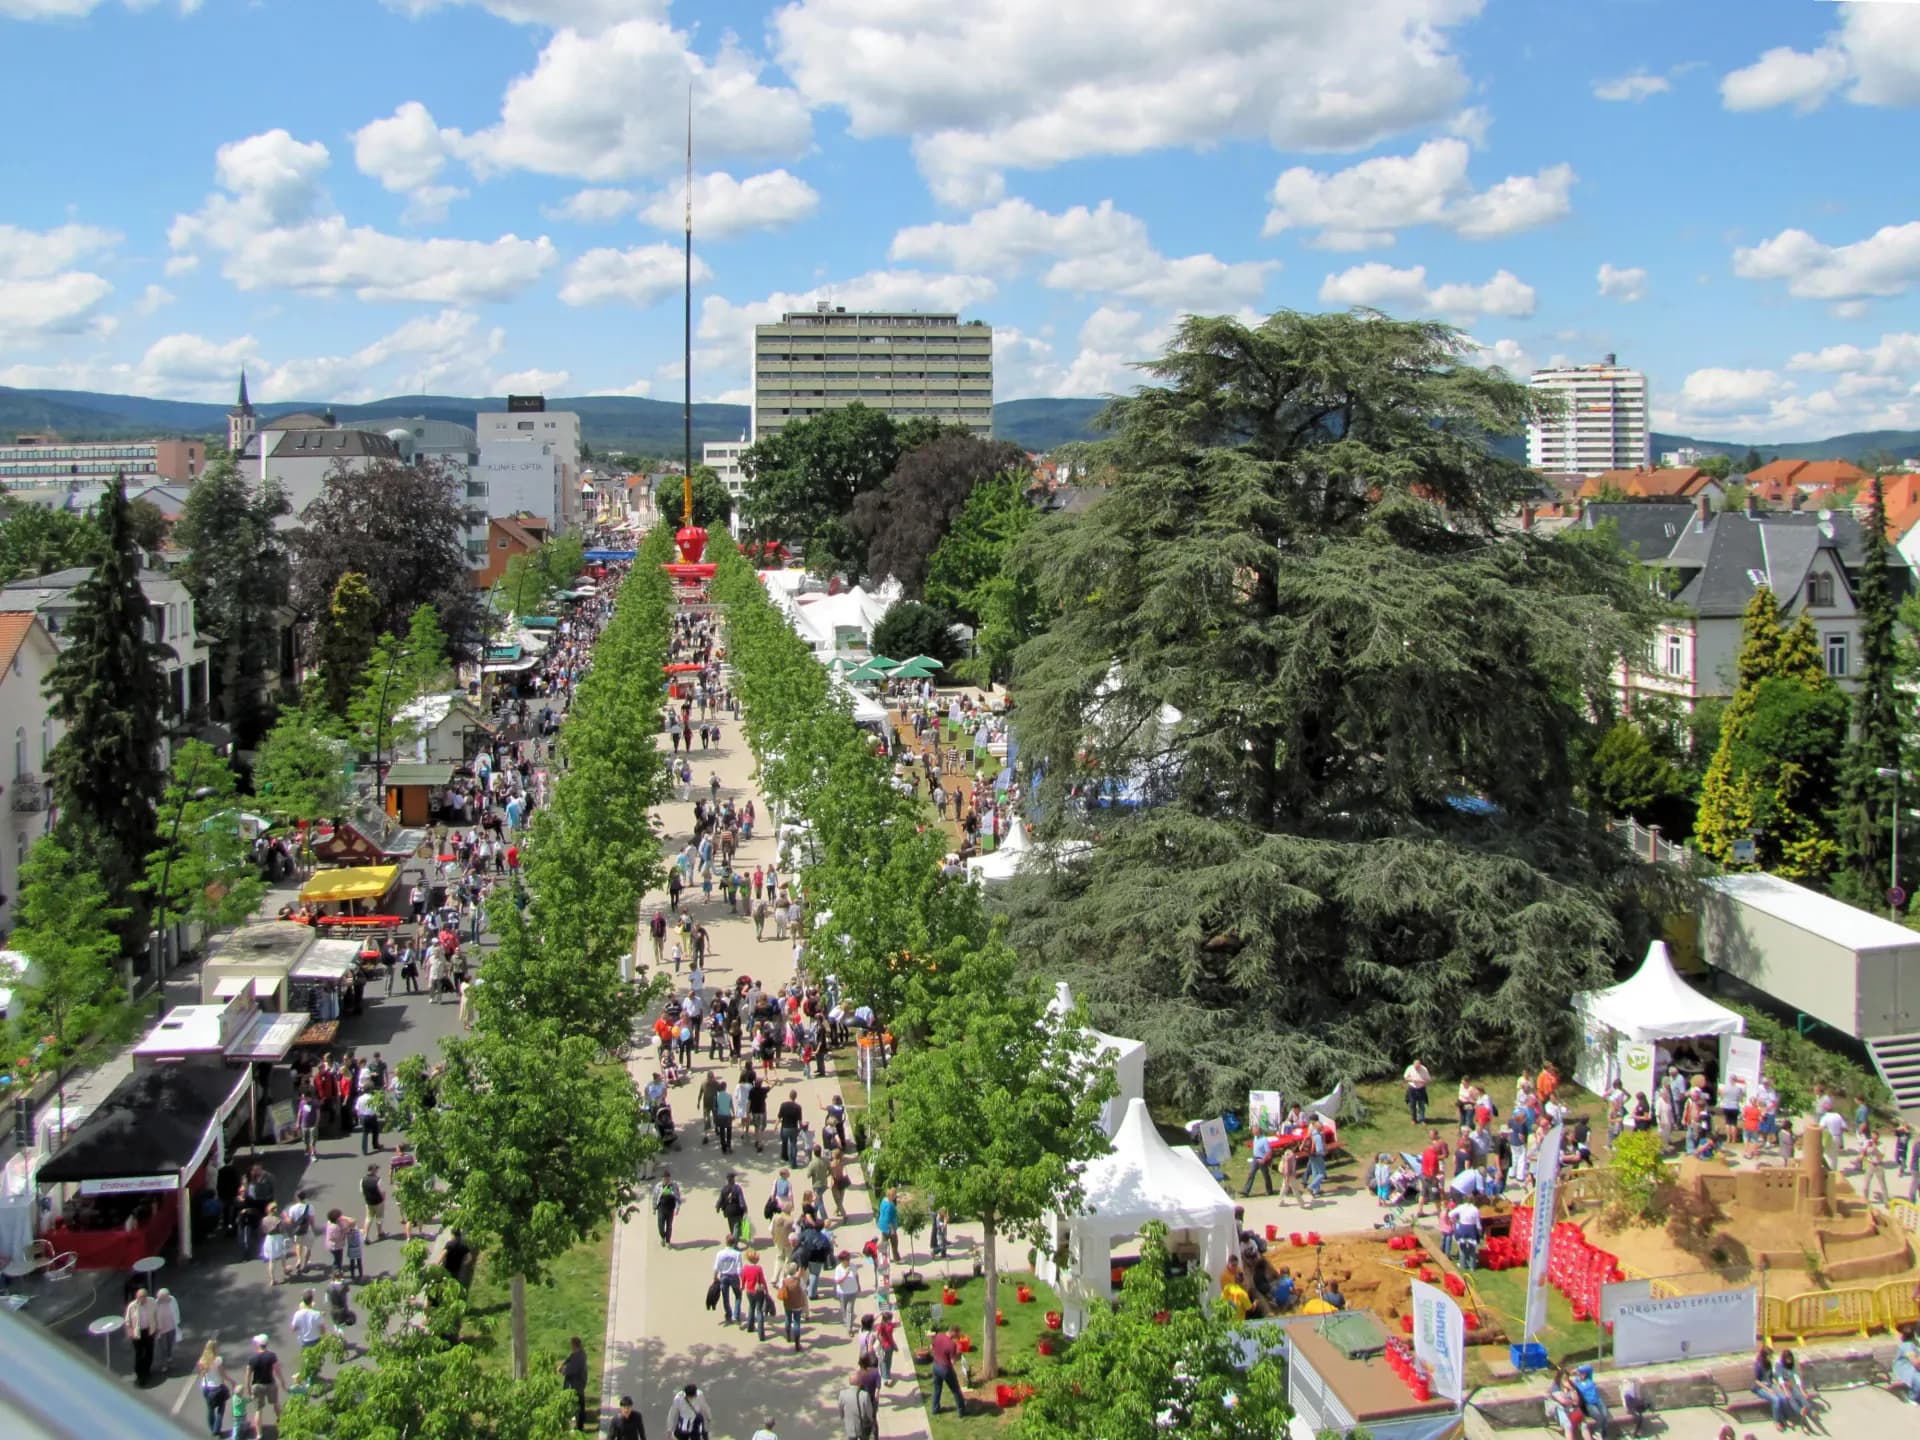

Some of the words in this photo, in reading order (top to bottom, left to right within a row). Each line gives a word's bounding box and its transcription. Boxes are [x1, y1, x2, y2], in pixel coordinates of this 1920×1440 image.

[520, 463, 544, 472] OPTIK
[1533, 1181, 1548, 1259] Taunus
[1619, 1300, 1688, 1316] BURGSTADT
[1690, 1293, 1743, 1308] EPPSTEIN
